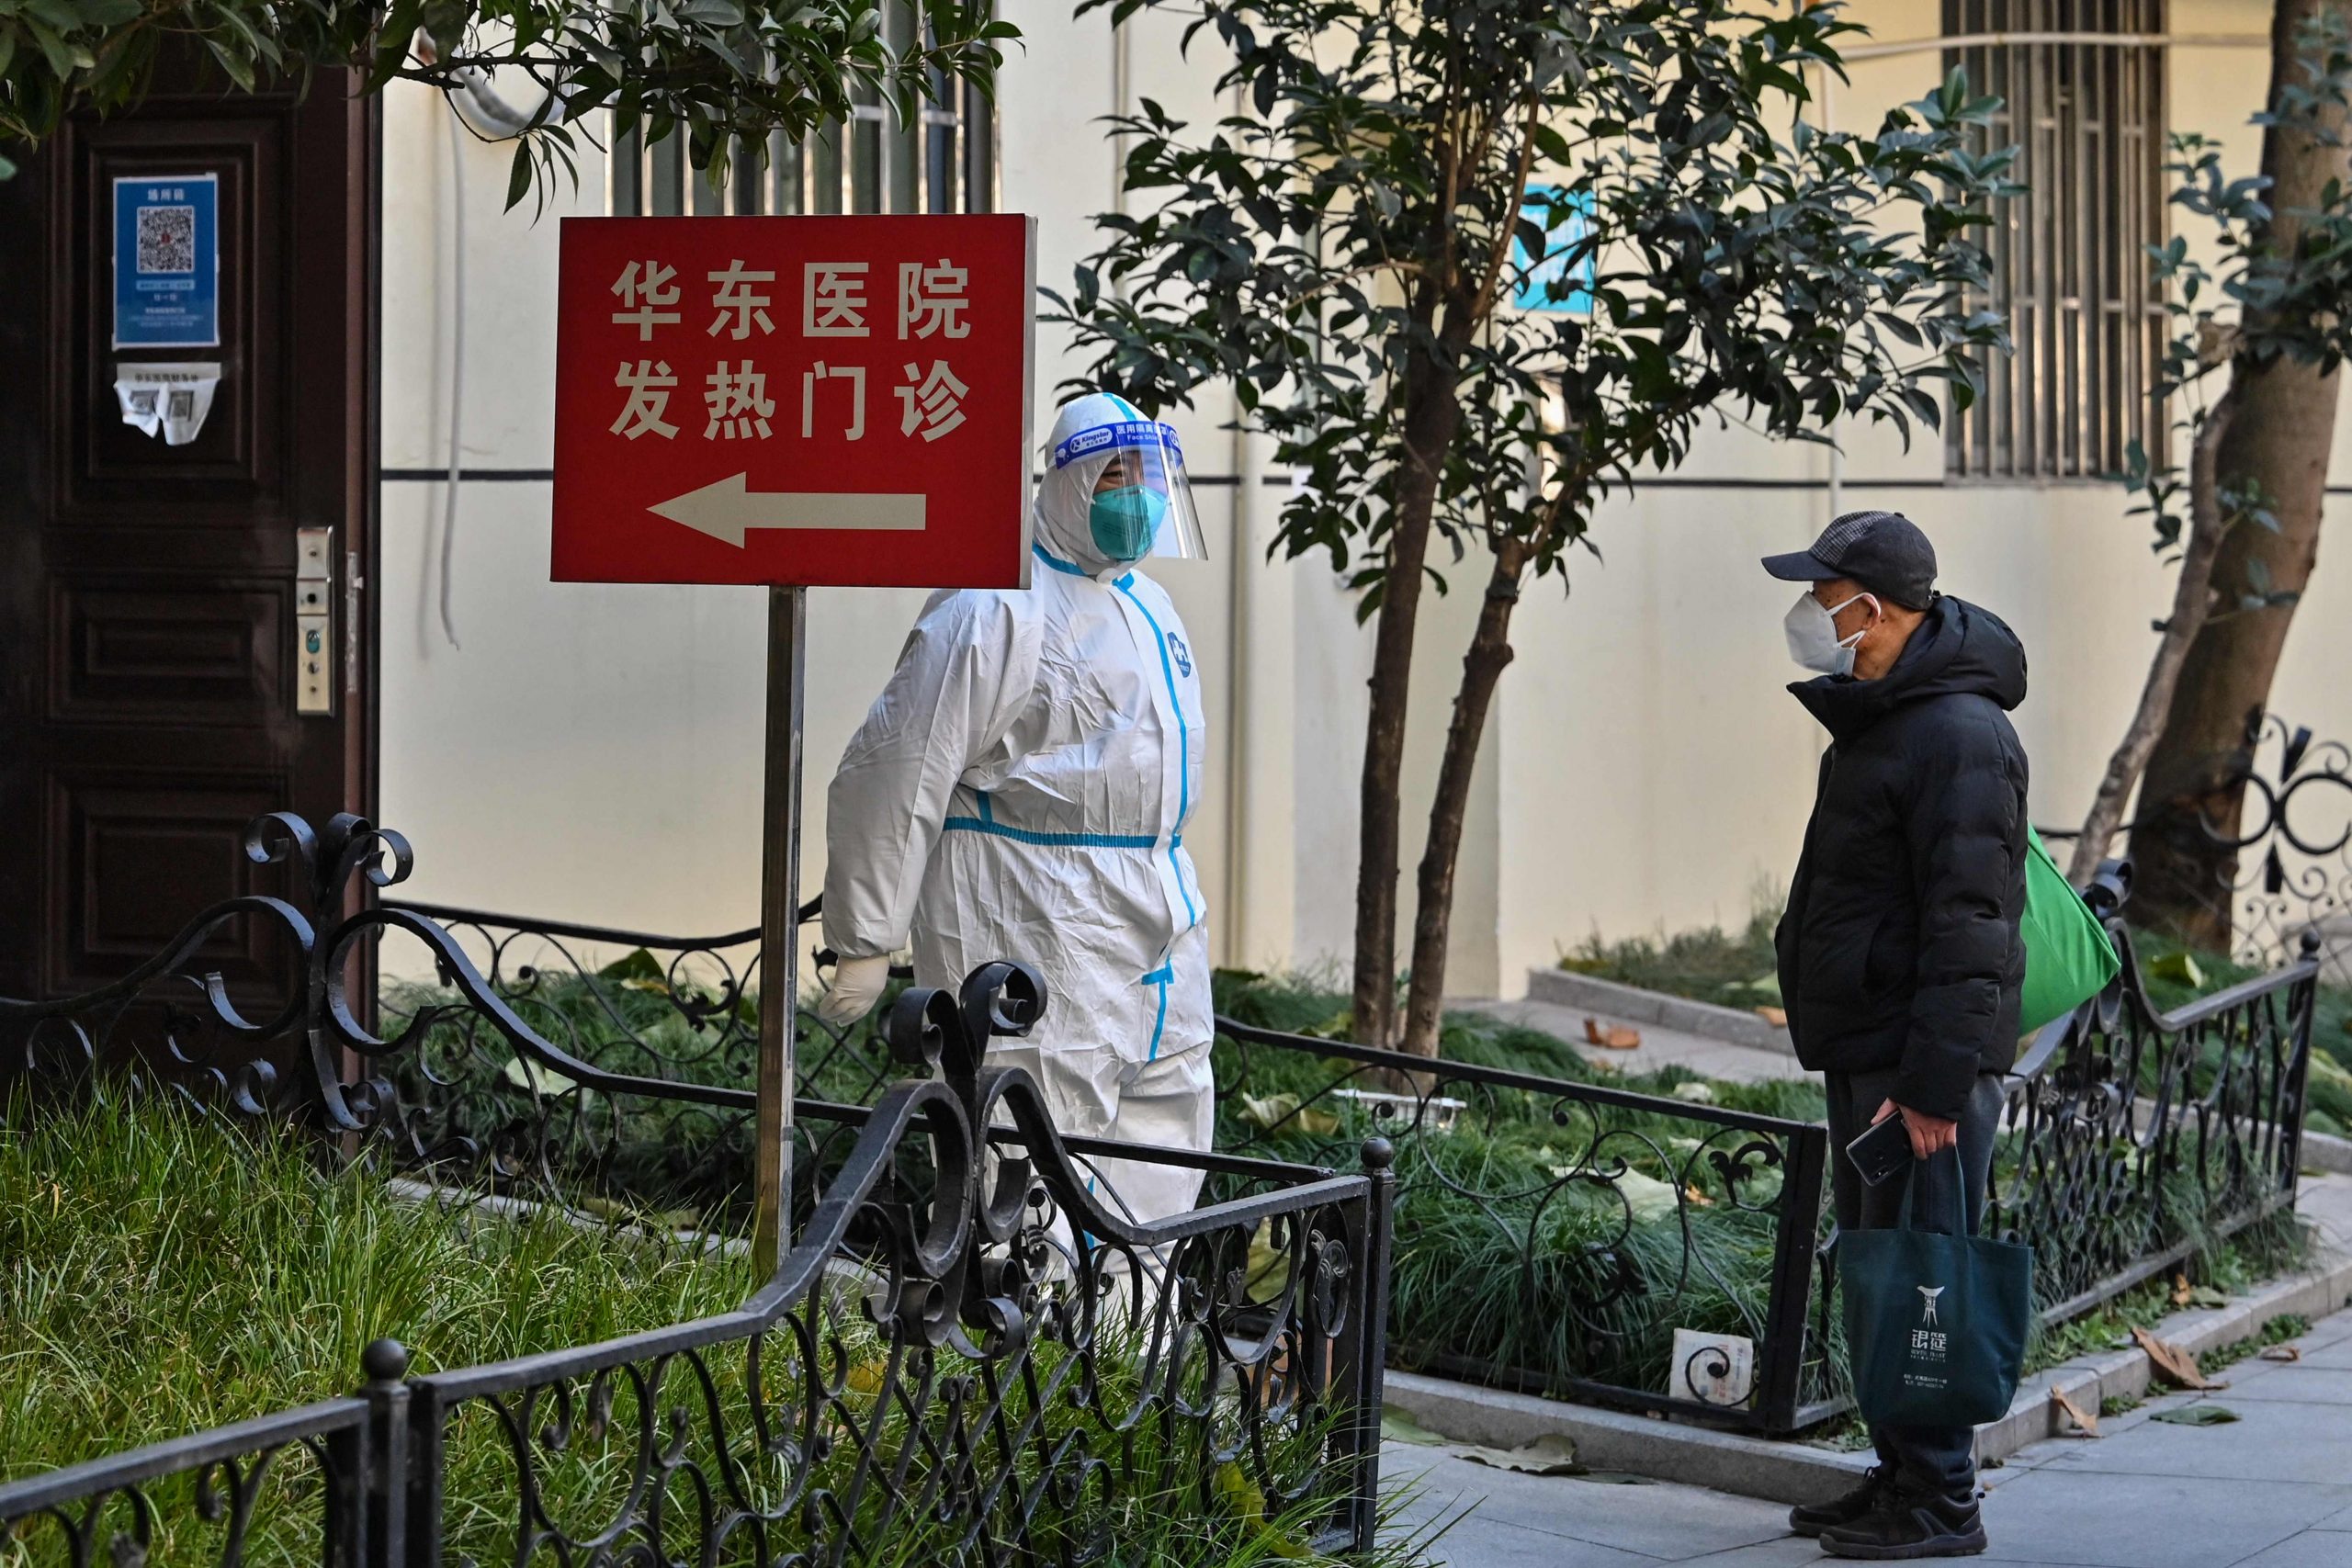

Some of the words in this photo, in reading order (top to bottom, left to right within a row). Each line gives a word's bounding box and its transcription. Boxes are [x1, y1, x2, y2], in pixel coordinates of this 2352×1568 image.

[610, 258, 971, 341] 华东医院
[609, 359, 970, 443] 发热门诊
[1081, 431, 1109, 442] Kingstar
